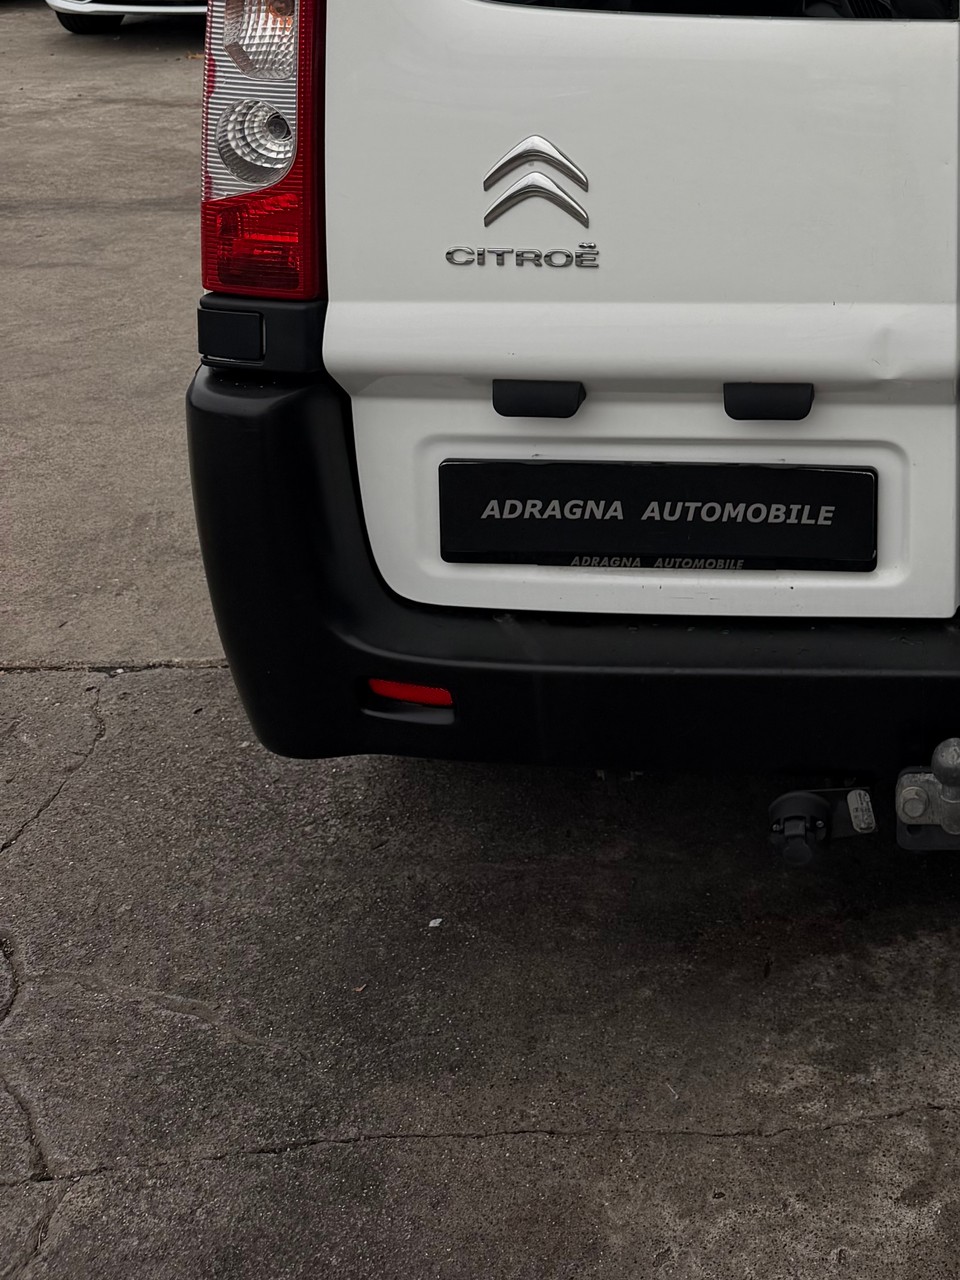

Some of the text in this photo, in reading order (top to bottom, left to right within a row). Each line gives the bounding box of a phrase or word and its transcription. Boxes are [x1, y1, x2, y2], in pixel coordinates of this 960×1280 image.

[480, 499, 836, 526] ADRAGNA AUTOMOBILE
[570, 556, 745, 570] ADRAGNA AUTOMOBILE
